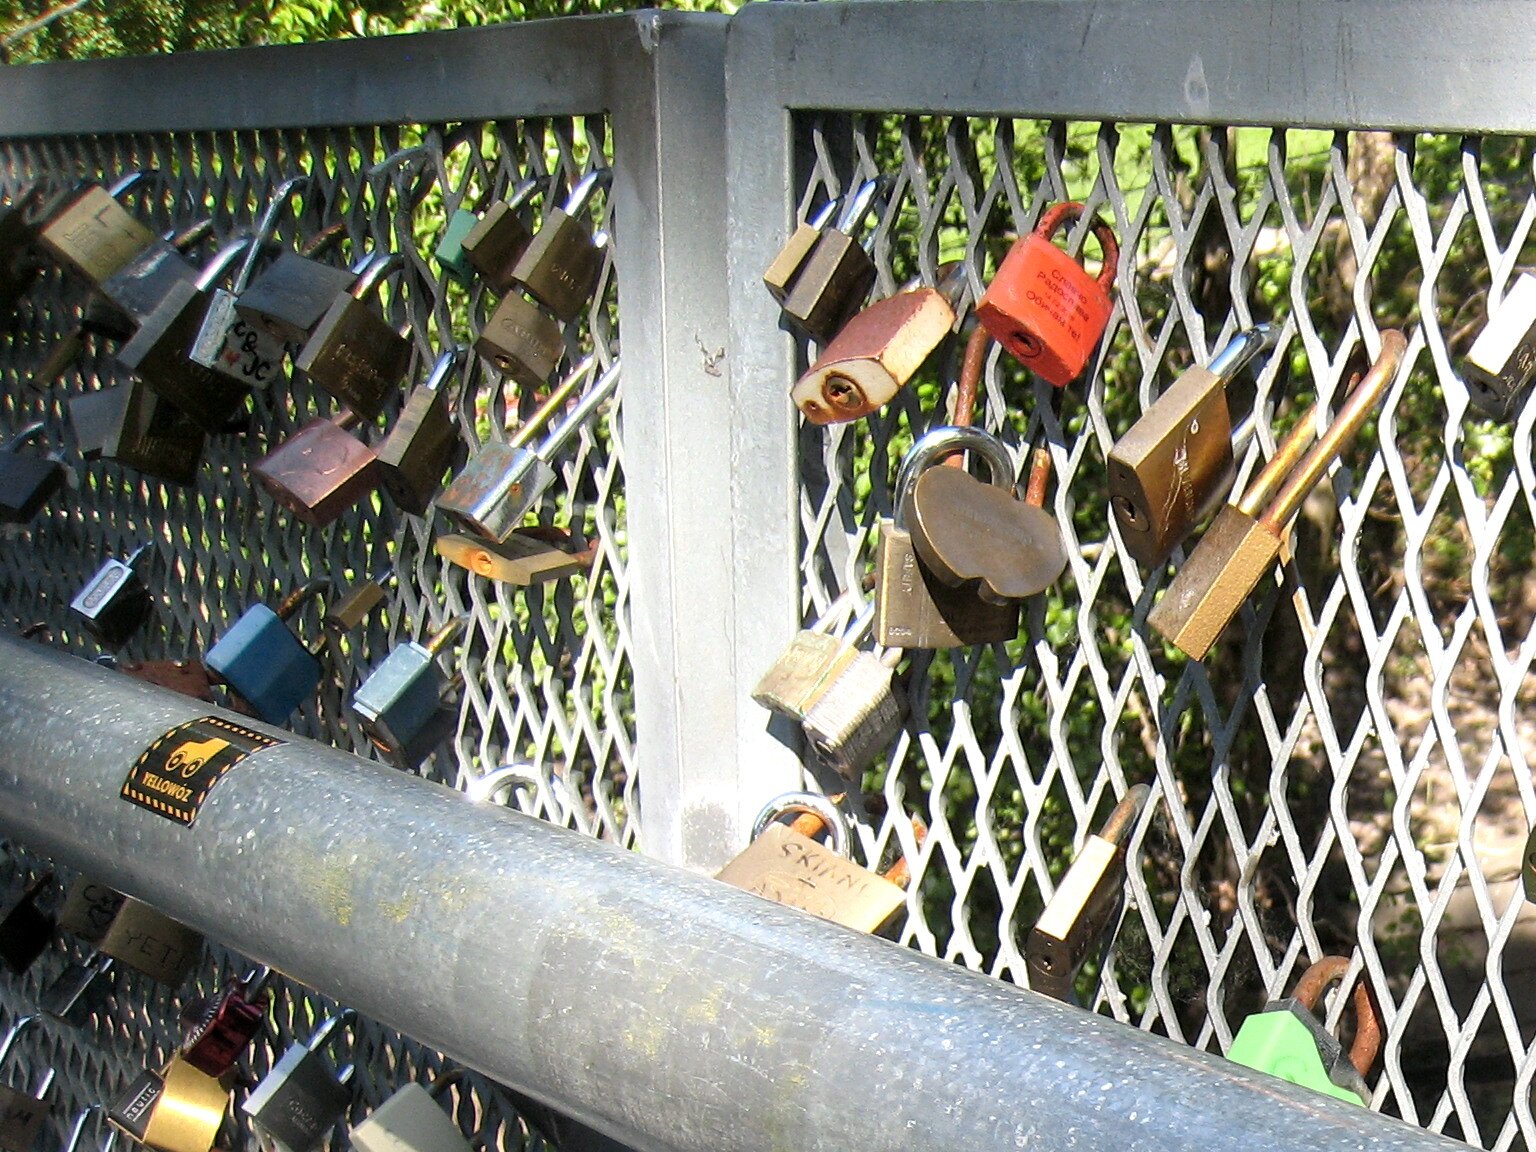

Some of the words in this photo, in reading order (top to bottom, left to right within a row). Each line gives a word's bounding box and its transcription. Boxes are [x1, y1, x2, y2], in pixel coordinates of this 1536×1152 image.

[141, 771, 193, 803] YELLOWÓZ
[126, 929, 185, 971] YETI
[126, 1087, 156, 1120] nautic
